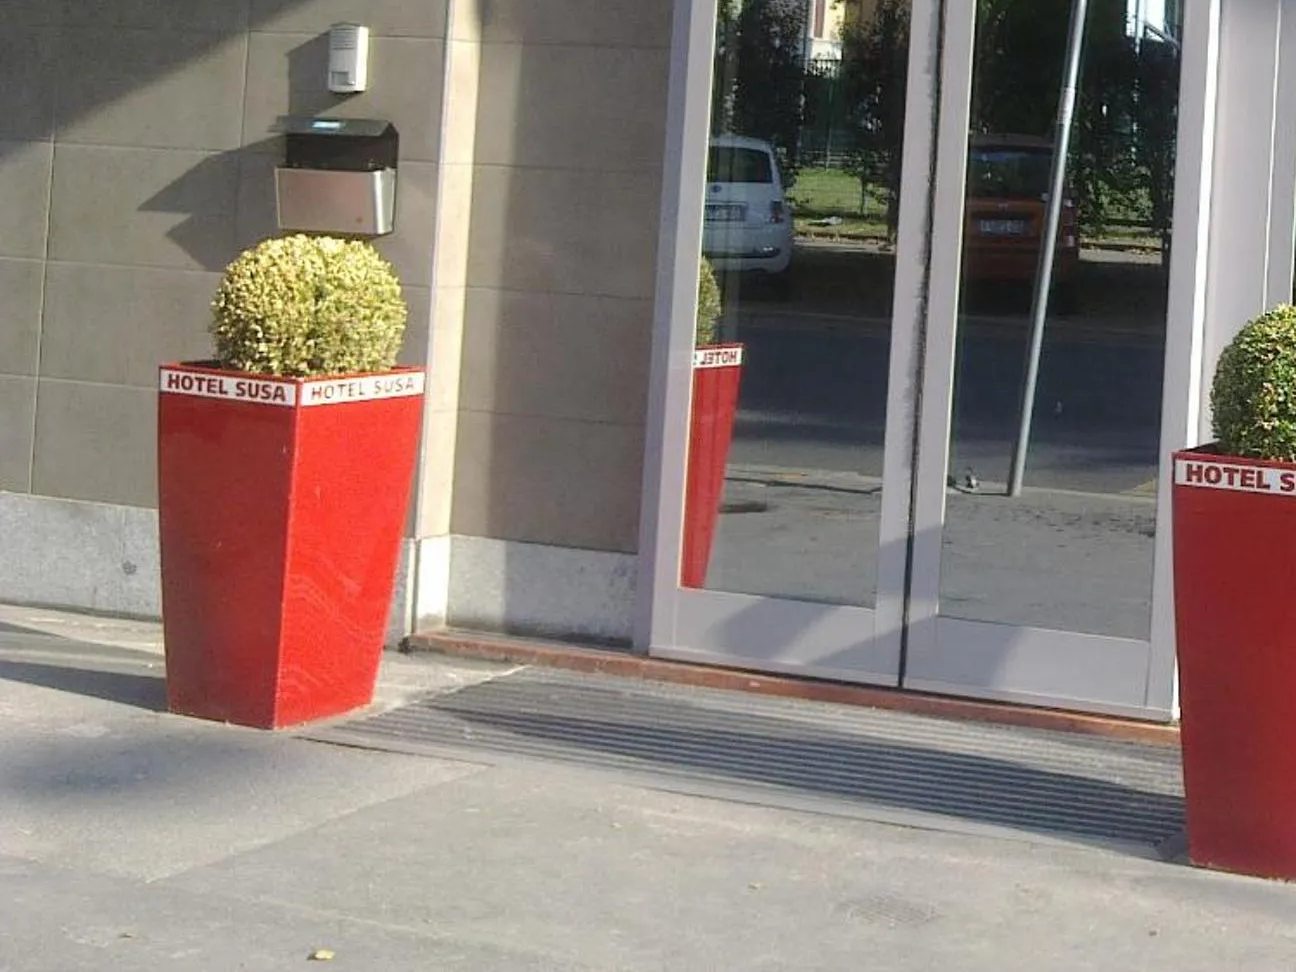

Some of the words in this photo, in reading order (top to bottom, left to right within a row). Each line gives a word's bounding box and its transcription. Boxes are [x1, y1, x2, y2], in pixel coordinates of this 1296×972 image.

[168, 374, 229, 398] HOTEL
[236, 381, 287, 403] SUSA
[311, 381, 365, 401] HOTEL
[374, 376, 414, 396] SUSA
[1186, 464, 1271, 491] HOTEL
